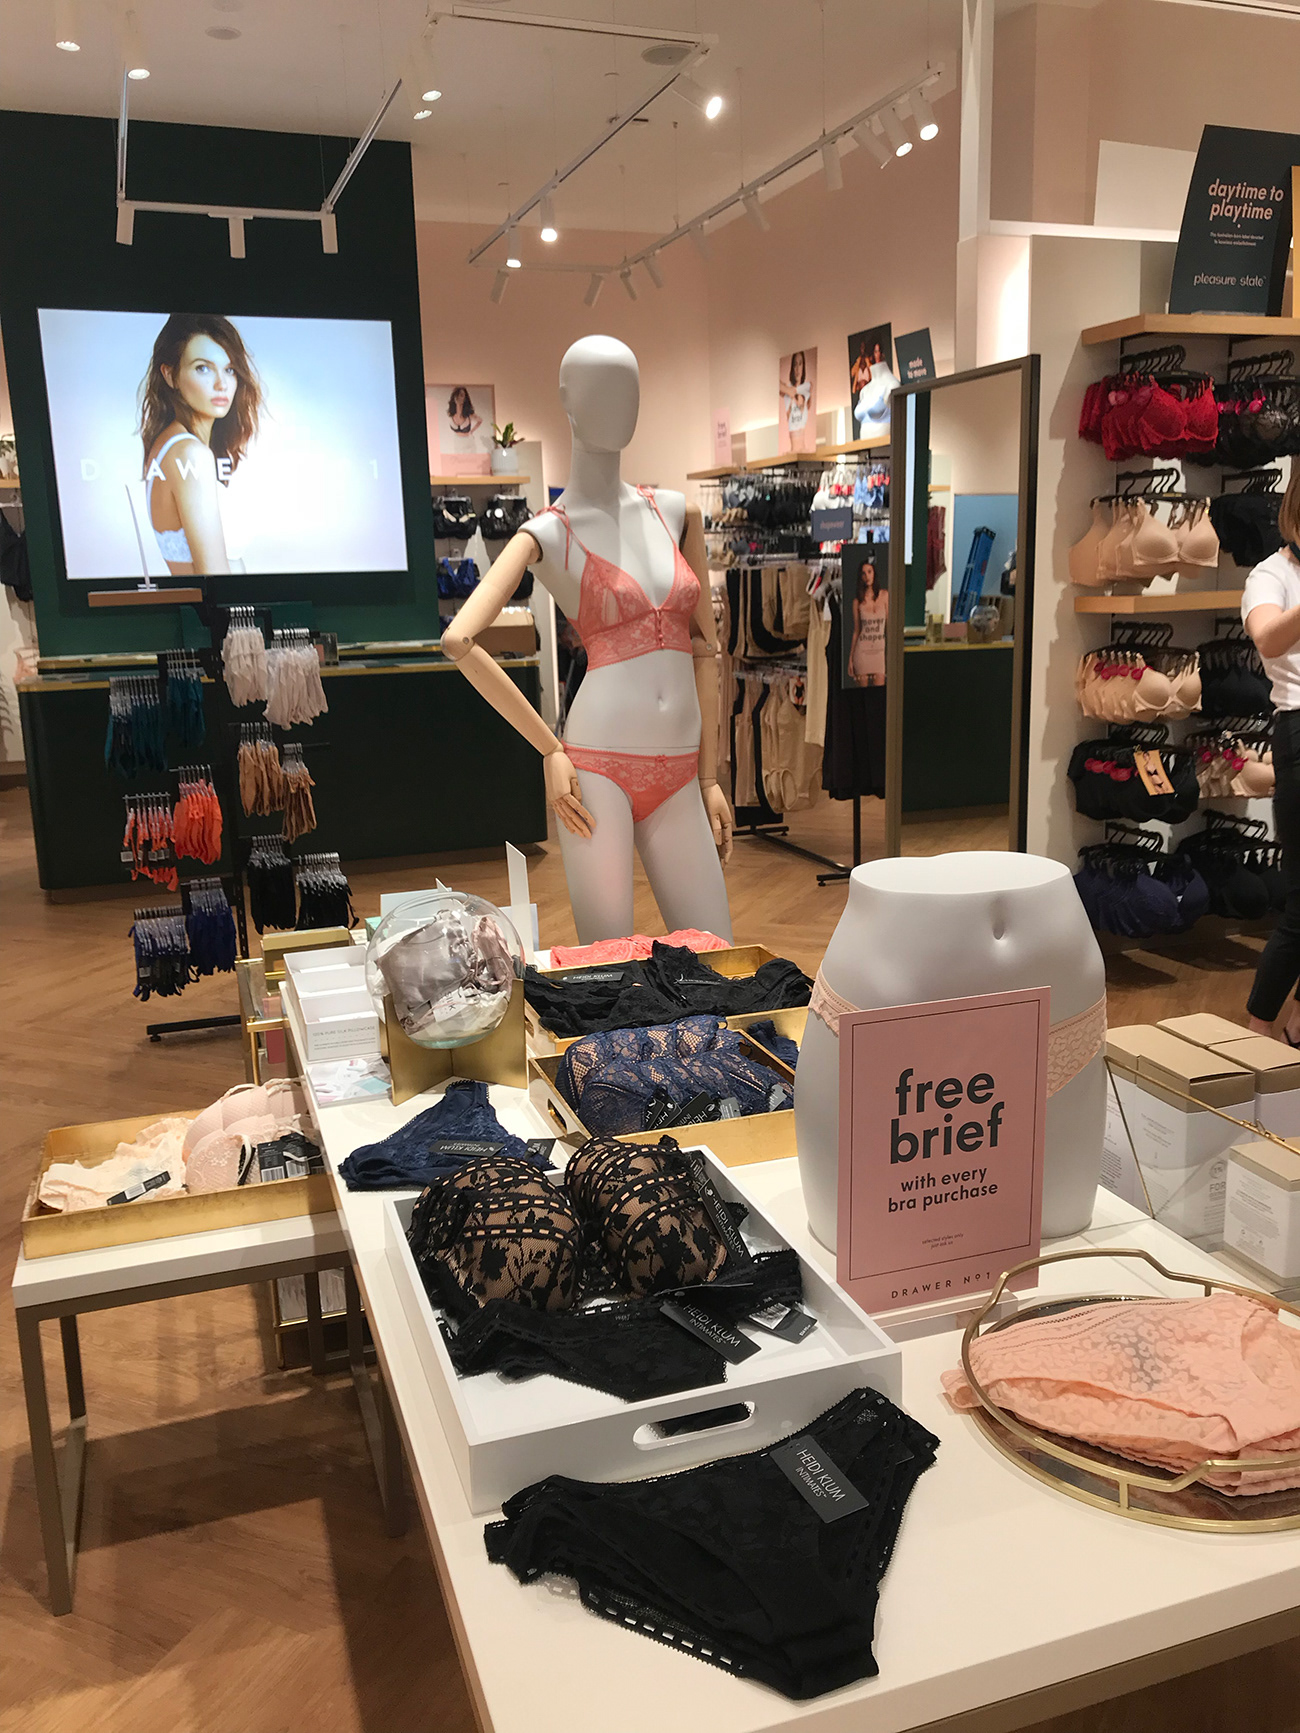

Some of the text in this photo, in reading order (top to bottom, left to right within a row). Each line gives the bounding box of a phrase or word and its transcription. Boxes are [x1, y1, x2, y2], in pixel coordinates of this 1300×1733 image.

[1208, 178, 1285, 203] daytime to
[1209, 198, 1273, 222] playtime
[1193, 272, 1264, 288] pleasure state
[865, 625, 880, 634] and
[895, 1068, 996, 1117] free
[890, 1101, 1005, 1164] brief
[900, 1167, 988, 1193] with every
[888, 1182, 999, 1213] bra purchase
[727, 1225, 745, 1258] KLUM
[891, 1279, 952, 1299] DRAWER
[683, 1304, 741, 1348] HEIDI KLUM
[689, 1318, 724, 1344] INTIMATES
[795, 1467, 825, 1498] INTIMATES
[796, 1448, 846, 1502] HEIDI KLUM
